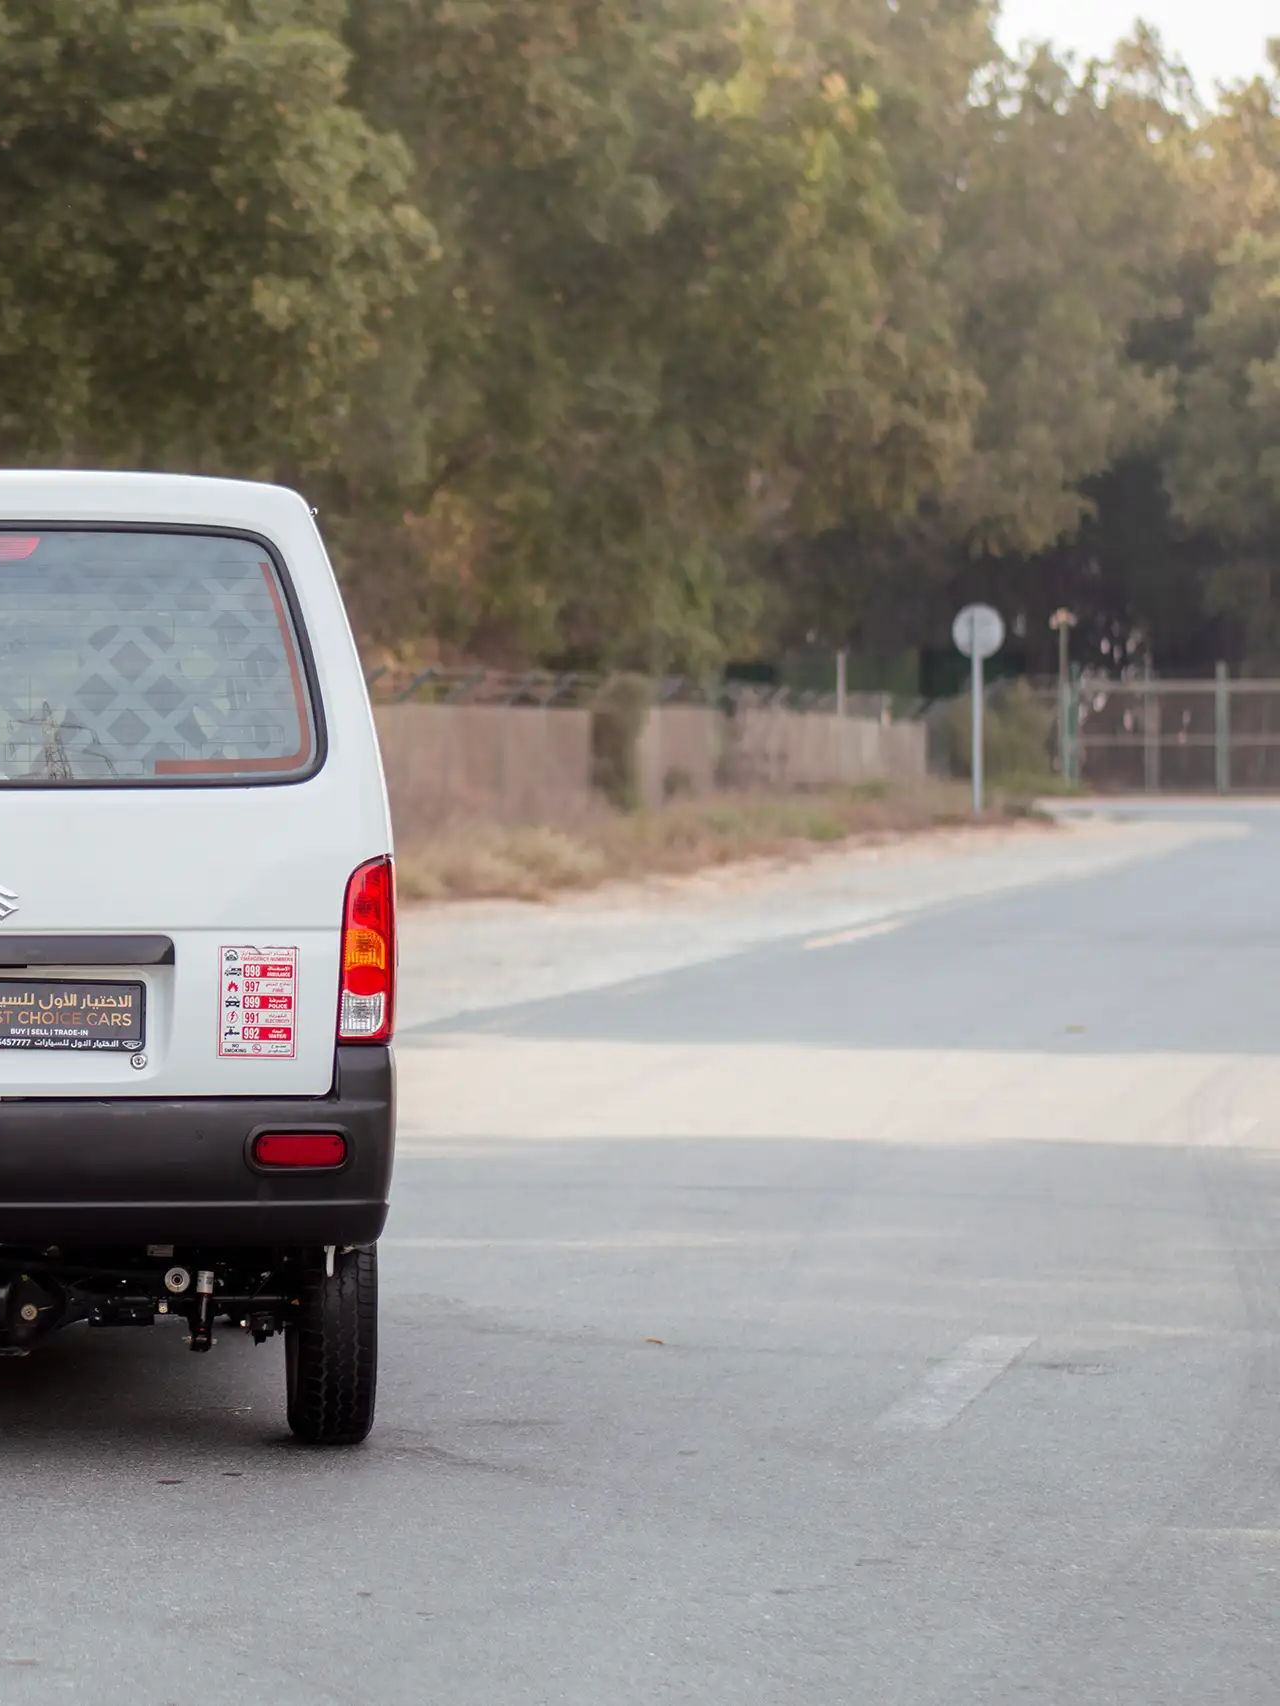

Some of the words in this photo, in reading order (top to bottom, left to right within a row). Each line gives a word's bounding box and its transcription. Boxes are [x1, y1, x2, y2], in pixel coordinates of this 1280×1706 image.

[245, 965, 261, 977] 998
[245, 981, 260, 992] 997
[38, 992, 77, 1010] الأول
[80, 994, 132, 1009] الاختيار
[244, 997, 261, 1009] 999
[17, 1011, 83, 1025] CHOICE
[86, 1013, 132, 1026] CARS
[245, 1012, 259, 1023] 991
[243, 1027, 260, 1039] 992
